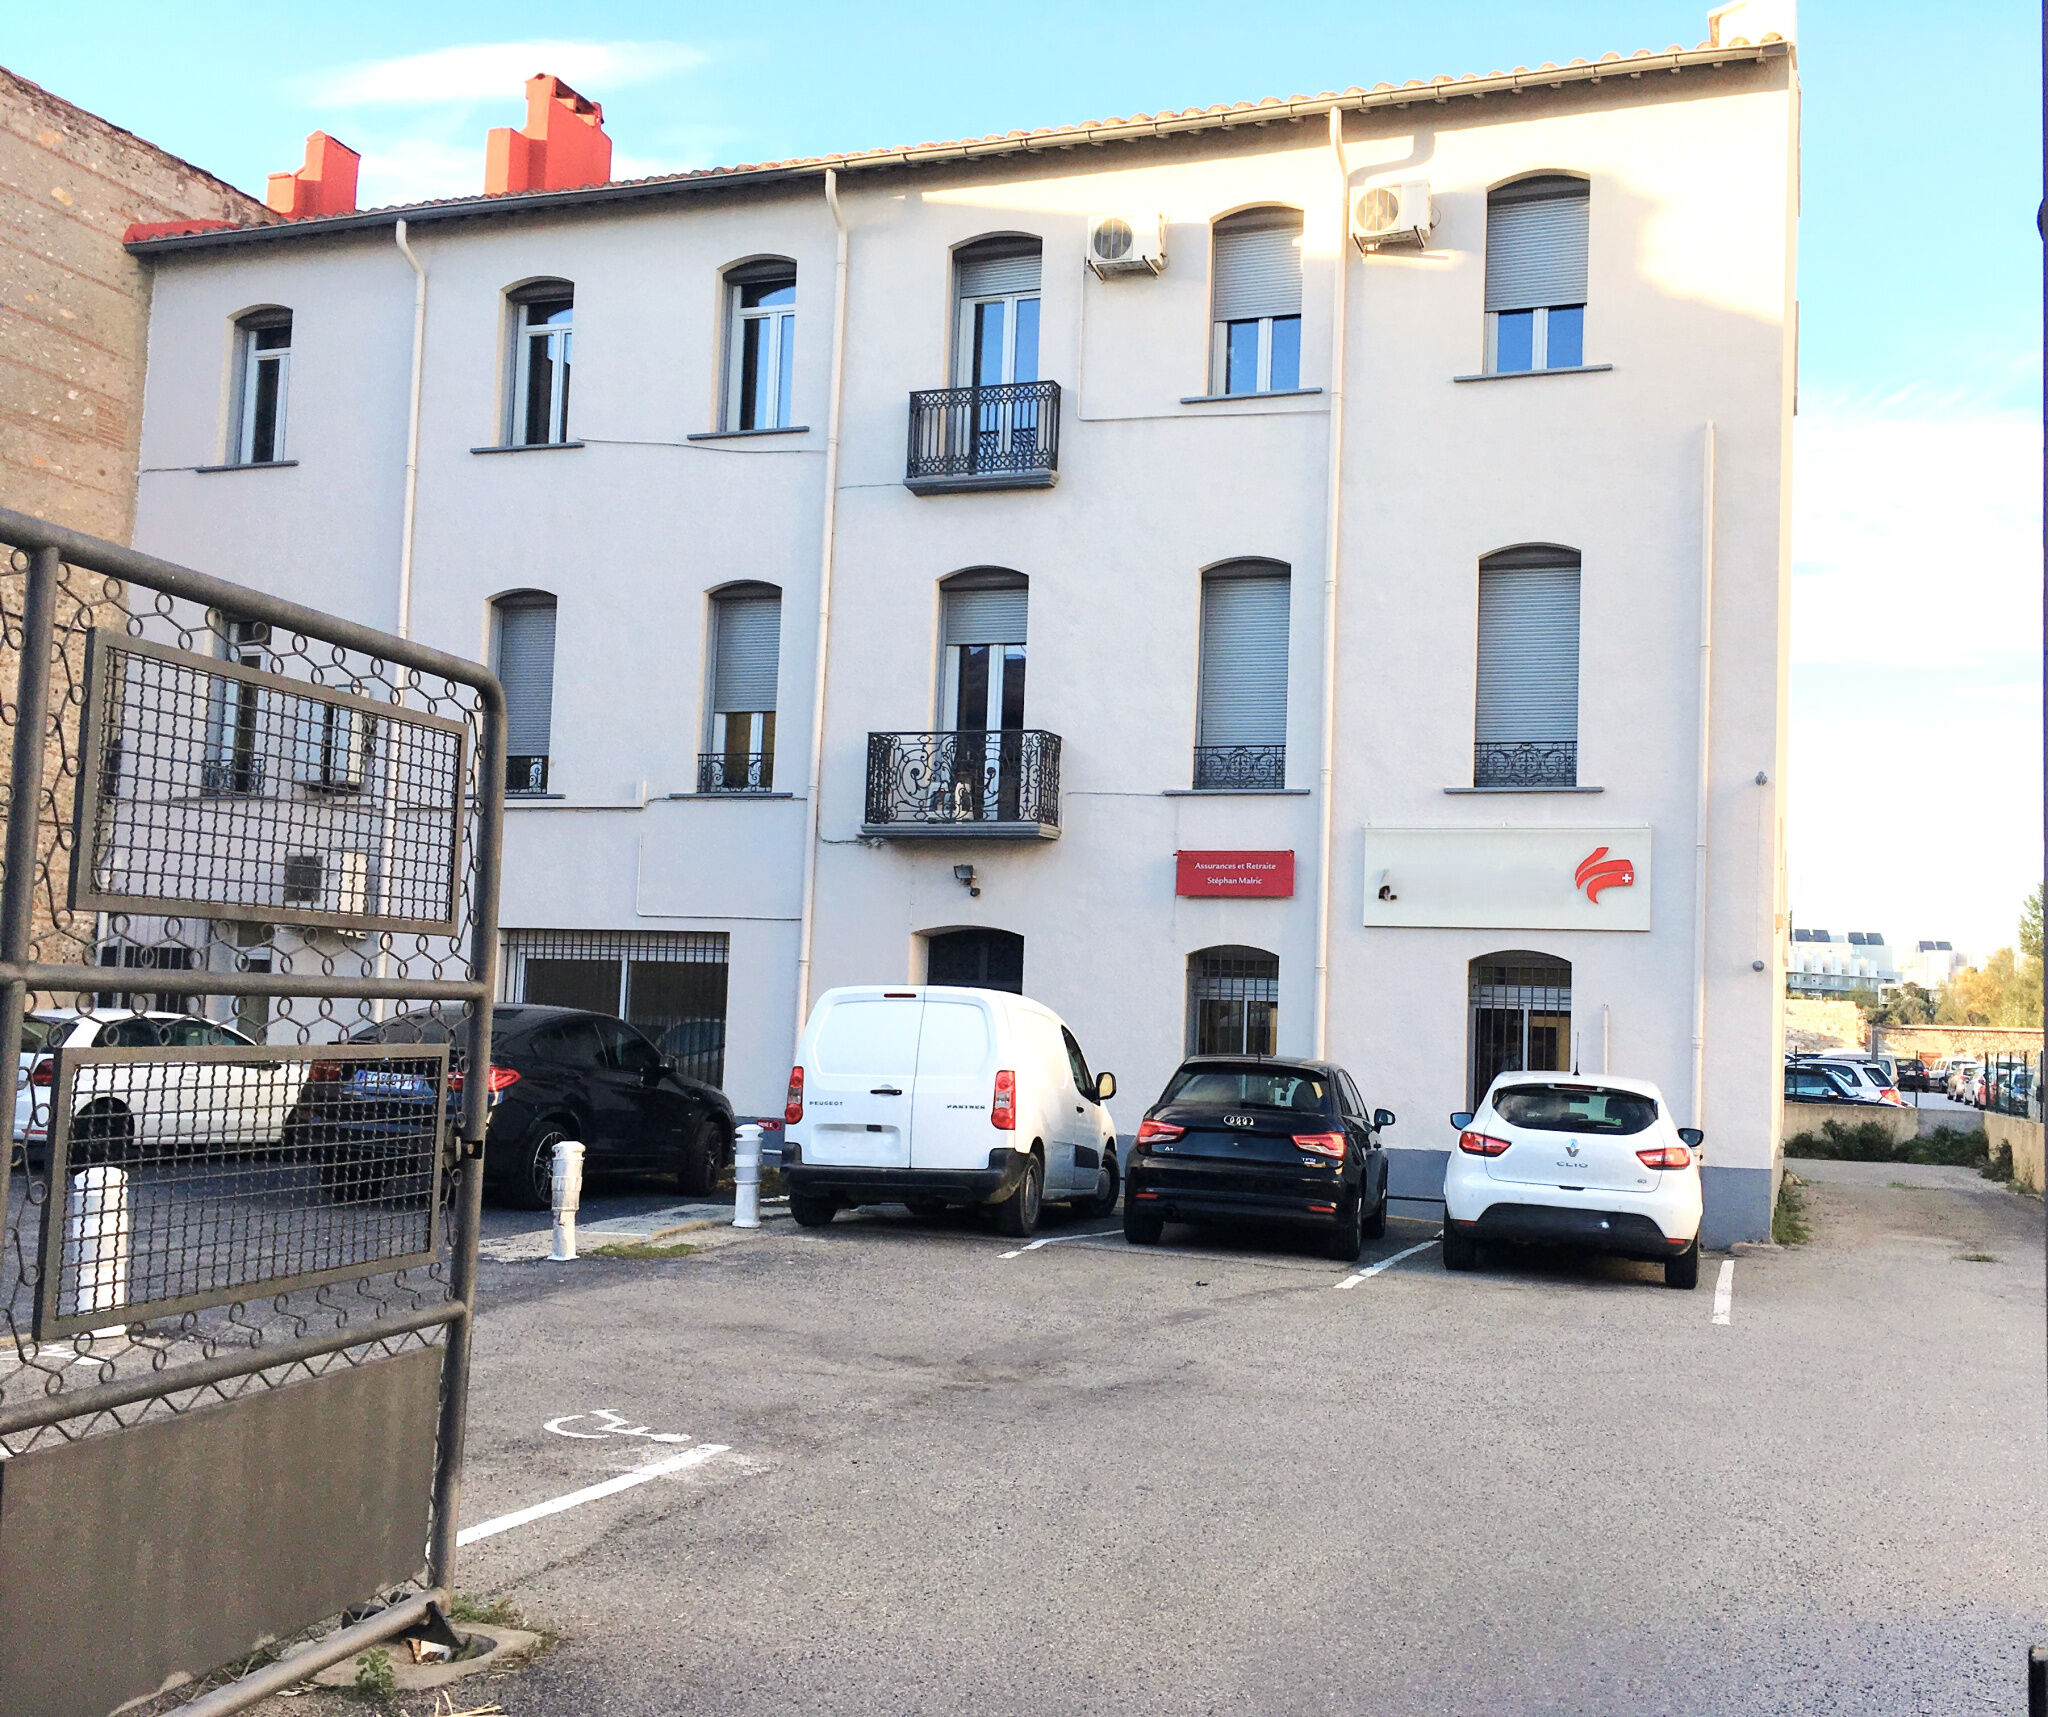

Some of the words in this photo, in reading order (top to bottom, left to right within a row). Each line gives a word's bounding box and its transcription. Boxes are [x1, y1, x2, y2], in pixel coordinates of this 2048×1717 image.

[1194, 862, 1236, 870] Assurances
[1246, 862, 1276, 870] Retraite
[1207, 876, 1238, 886] Stéphan
